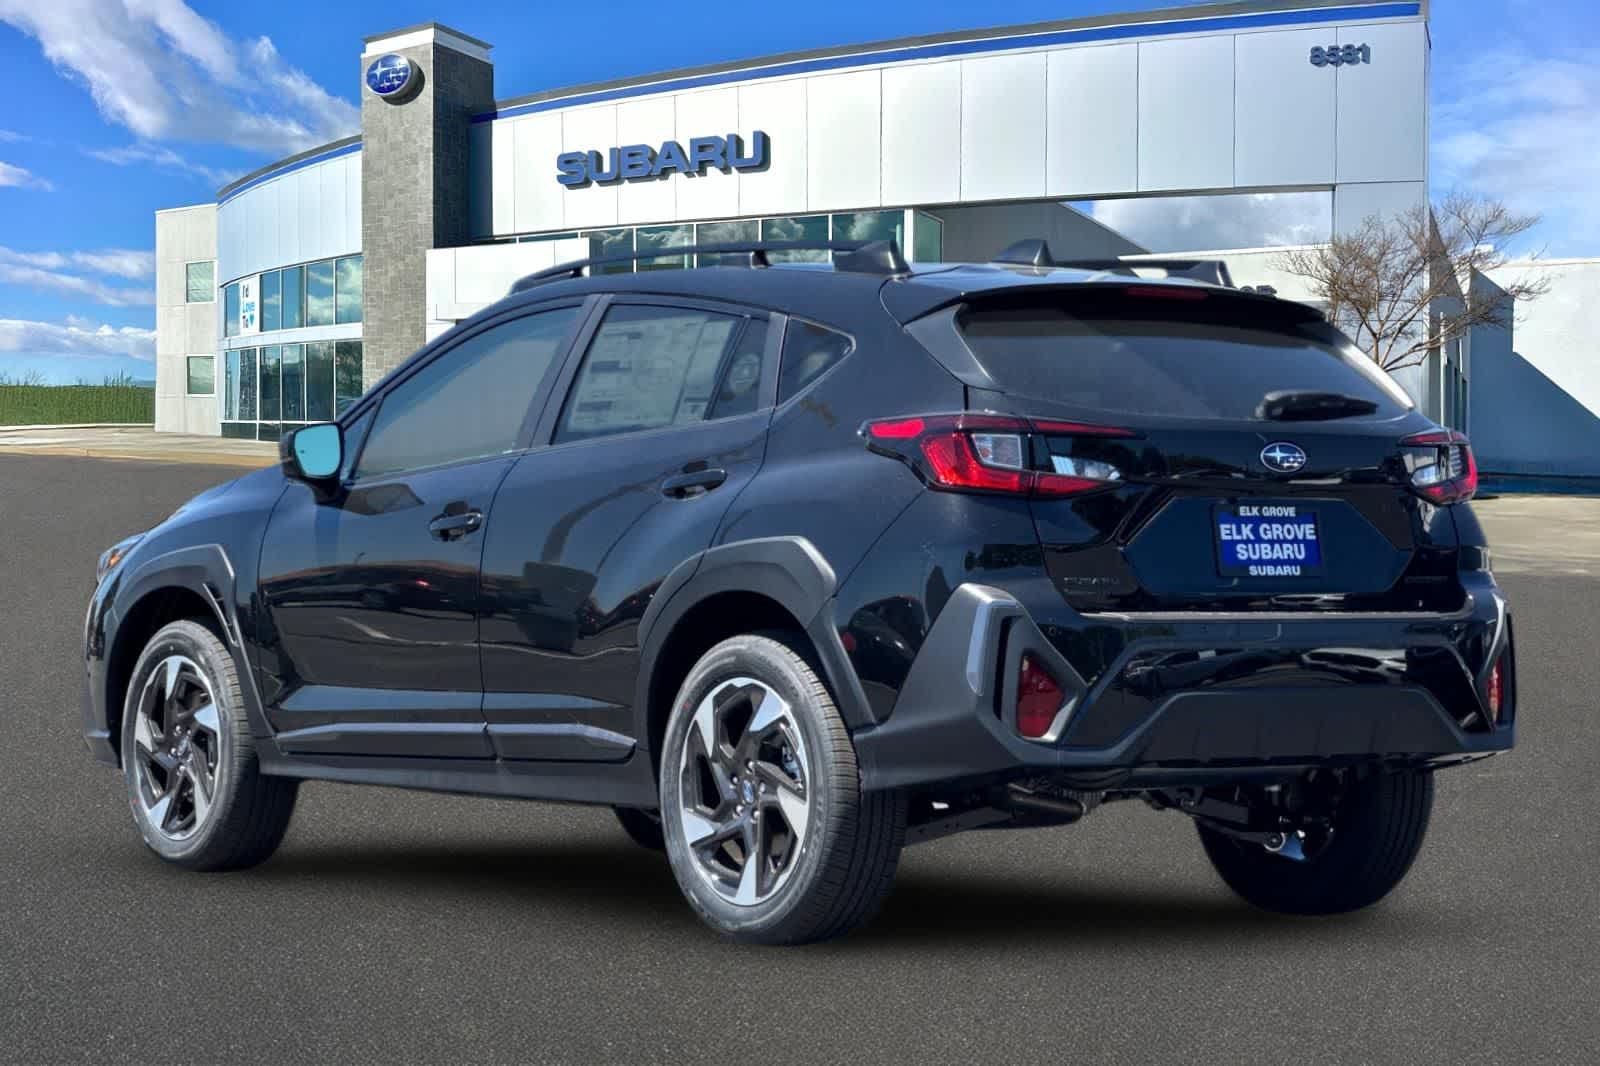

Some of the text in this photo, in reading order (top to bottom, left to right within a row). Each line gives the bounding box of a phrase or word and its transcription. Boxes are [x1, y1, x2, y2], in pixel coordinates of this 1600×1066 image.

[556, 130, 771, 190] SUBARU
[1239, 506, 1296, 517] ELK GROVE
[1219, 523, 1317, 540] ELK GROVE
[1236, 543, 1306, 560] SUBARU
[1248, 565, 1302, 576] SUBARU
